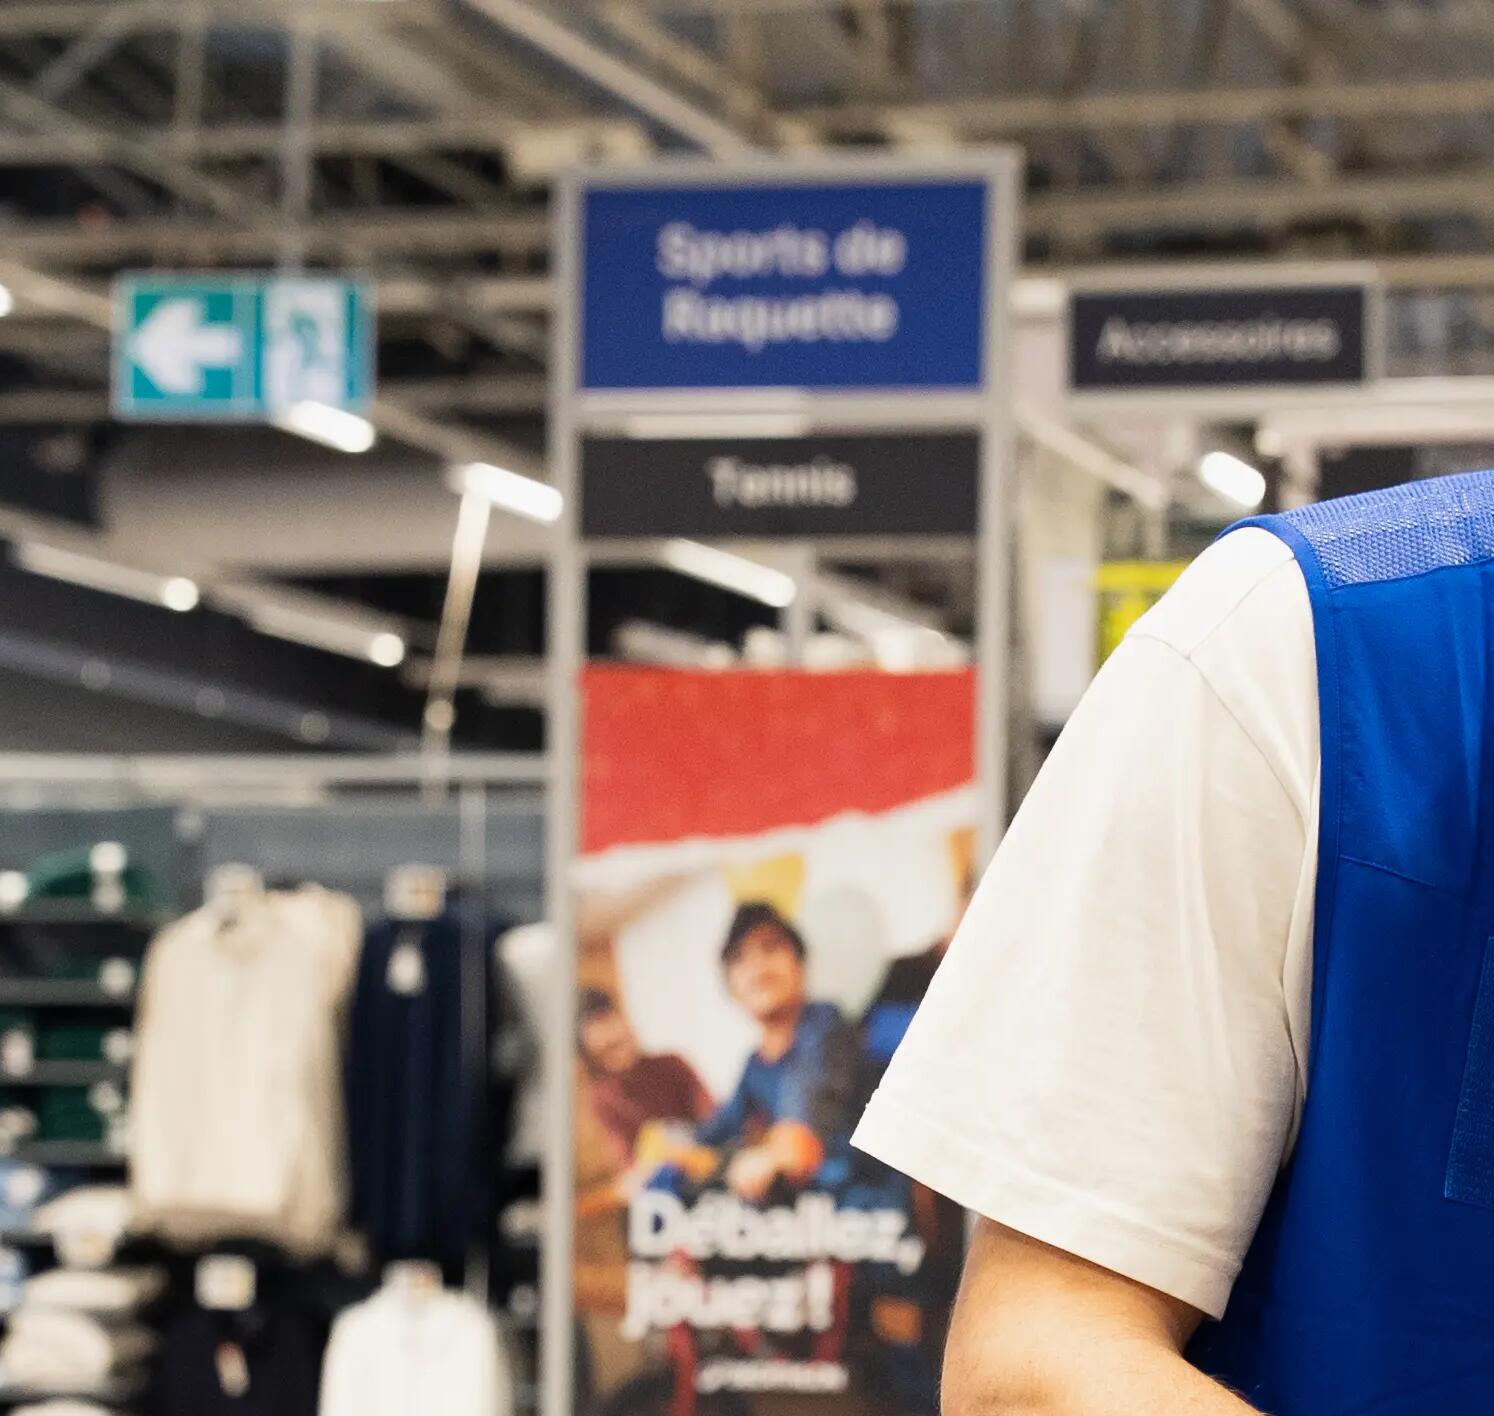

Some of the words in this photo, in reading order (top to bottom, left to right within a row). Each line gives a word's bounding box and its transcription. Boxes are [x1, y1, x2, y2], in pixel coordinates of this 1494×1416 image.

[657, 221, 829, 287] Sports
[834, 219, 907, 277] de
[661, 286, 898, 351] Raquette
[1097, 314, 1341, 364] Accessoires
[705, 454, 858, 508] Tennis
[628, 1189, 926, 1276] Déballez,
